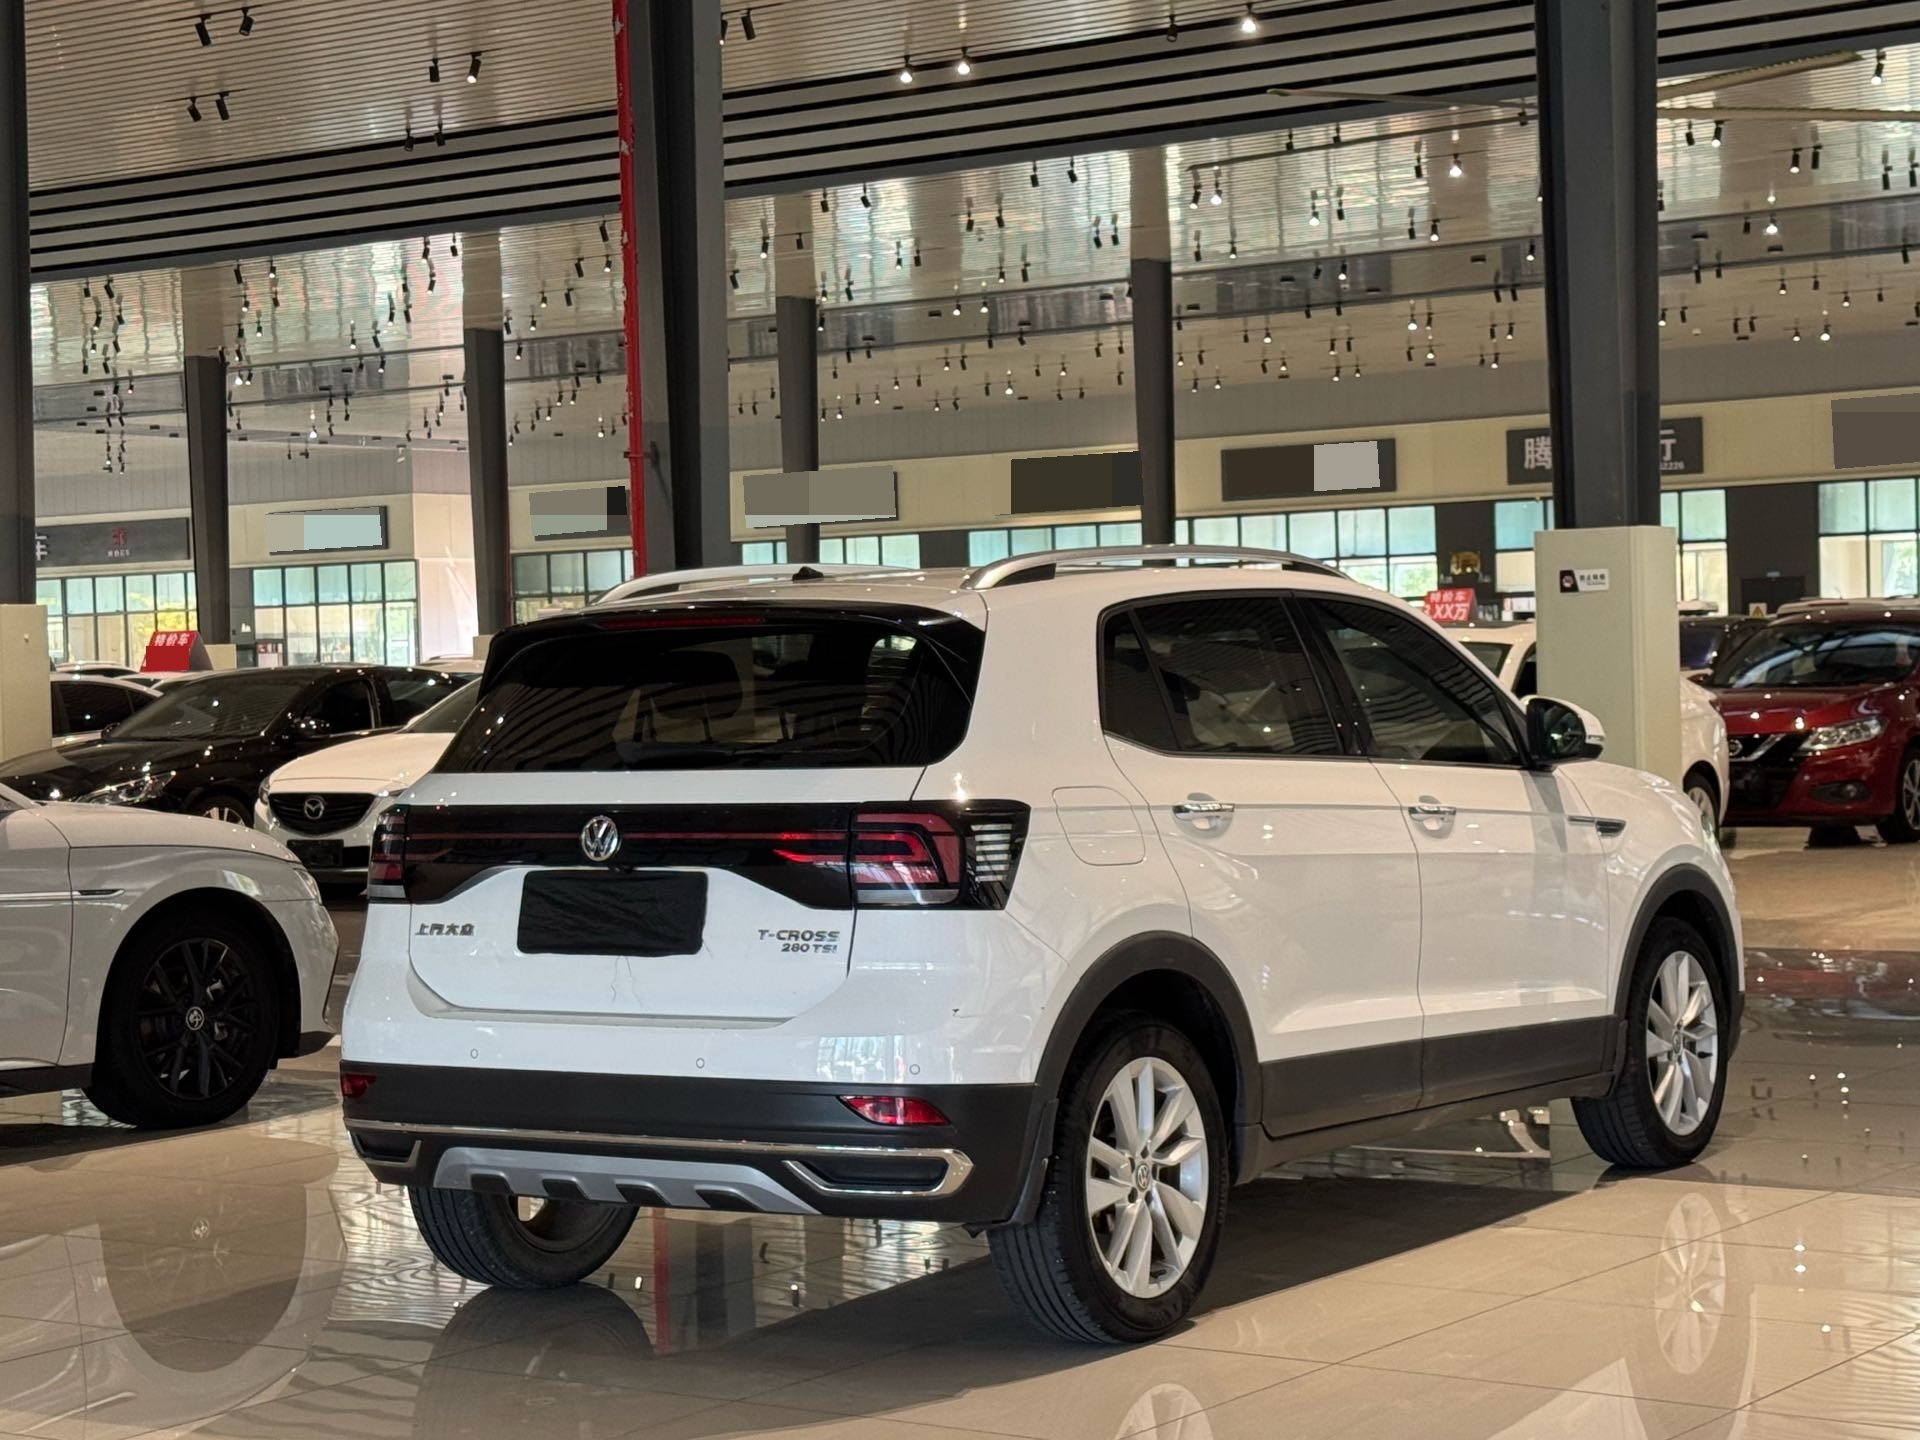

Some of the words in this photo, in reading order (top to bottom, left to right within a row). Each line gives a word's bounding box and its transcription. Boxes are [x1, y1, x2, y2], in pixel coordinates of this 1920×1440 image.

[154, 633, 190, 646] 特价车
[758, 929, 841, 942] T-CROSS
[781, 943, 810, 953] 280
